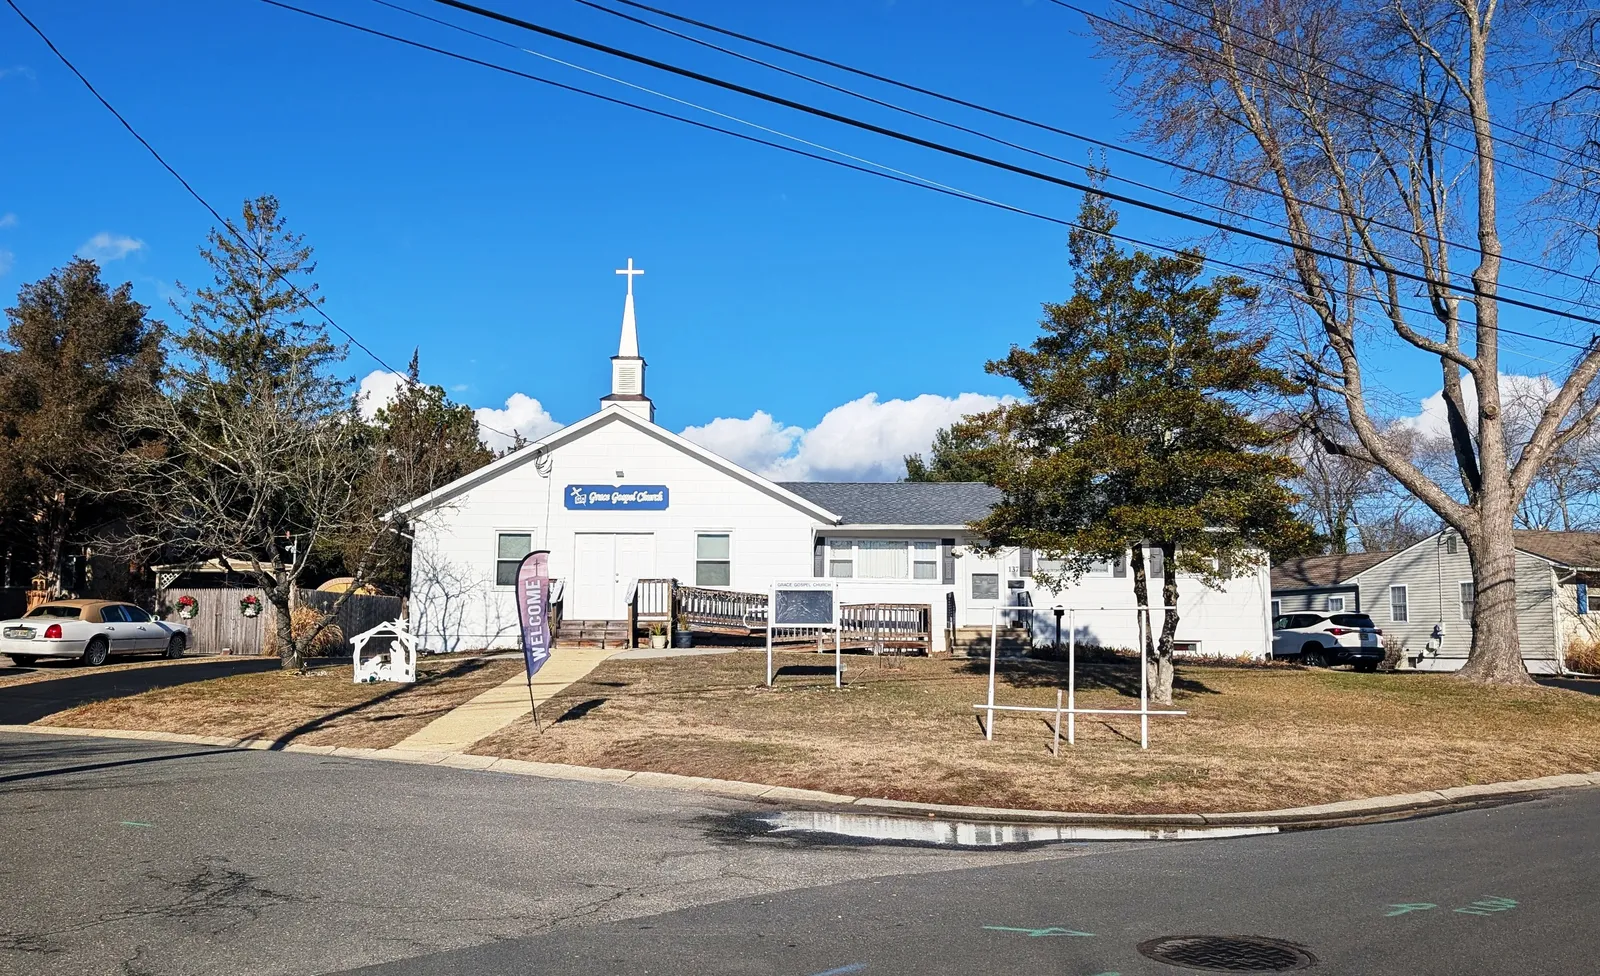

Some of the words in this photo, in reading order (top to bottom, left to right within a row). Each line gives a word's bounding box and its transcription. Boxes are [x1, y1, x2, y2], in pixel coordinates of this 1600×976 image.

[589, 492, 610, 504] Grace
[611, 491, 638, 504] Gospel
[637, 491, 663, 503] Church
[525, 579, 546, 662] WELCOME
